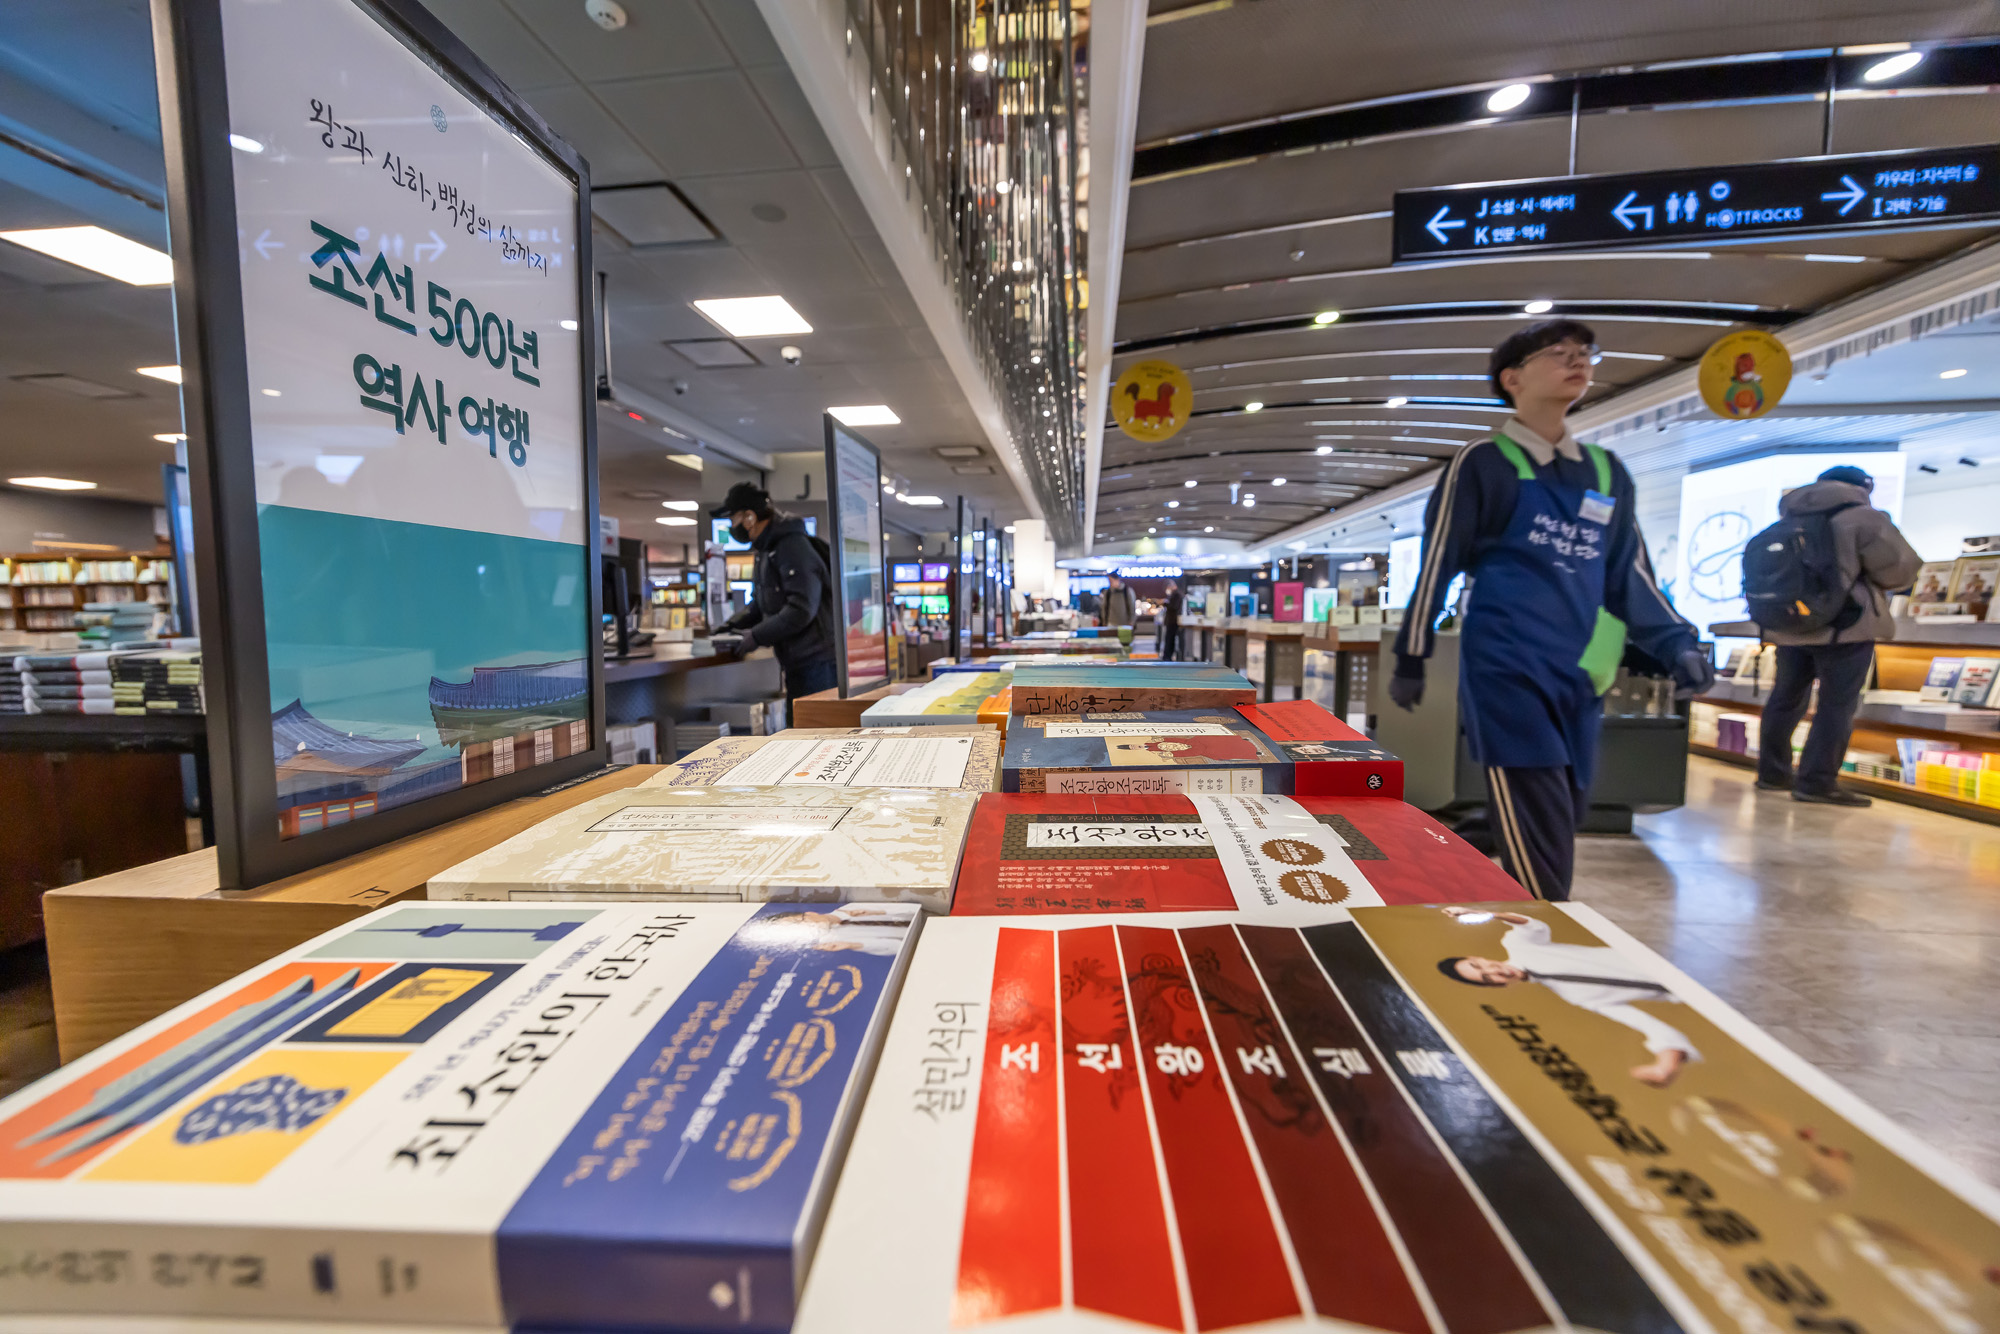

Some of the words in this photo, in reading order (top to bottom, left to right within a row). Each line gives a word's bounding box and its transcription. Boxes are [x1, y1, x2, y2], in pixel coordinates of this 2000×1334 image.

[309, 98, 373, 165] 왕과
[382, 151, 437, 212] 신하,
[437, 181, 493, 243] 백성의
[1474, 226, 1489, 245] K
[1492, 223, 1546, 242] 인문·역사
[1475, 199, 1488, 218] J
[308, 219, 418, 337] 조선
[427, 280, 541, 388] 500년
[353, 352, 452, 446] 역사
[458, 395, 530, 468] 여행
[1107, 566, 1183, 578] ARBUCKS
[1060, 776, 1171, 794] 조선왕조실록
[1294, 875, 1315, 897] 2017년
[388, 992, 612, 1177] 최소한의
[583, 914, 697, 981] 한국사
[913, 1001, 981, 1122] 설민석의
